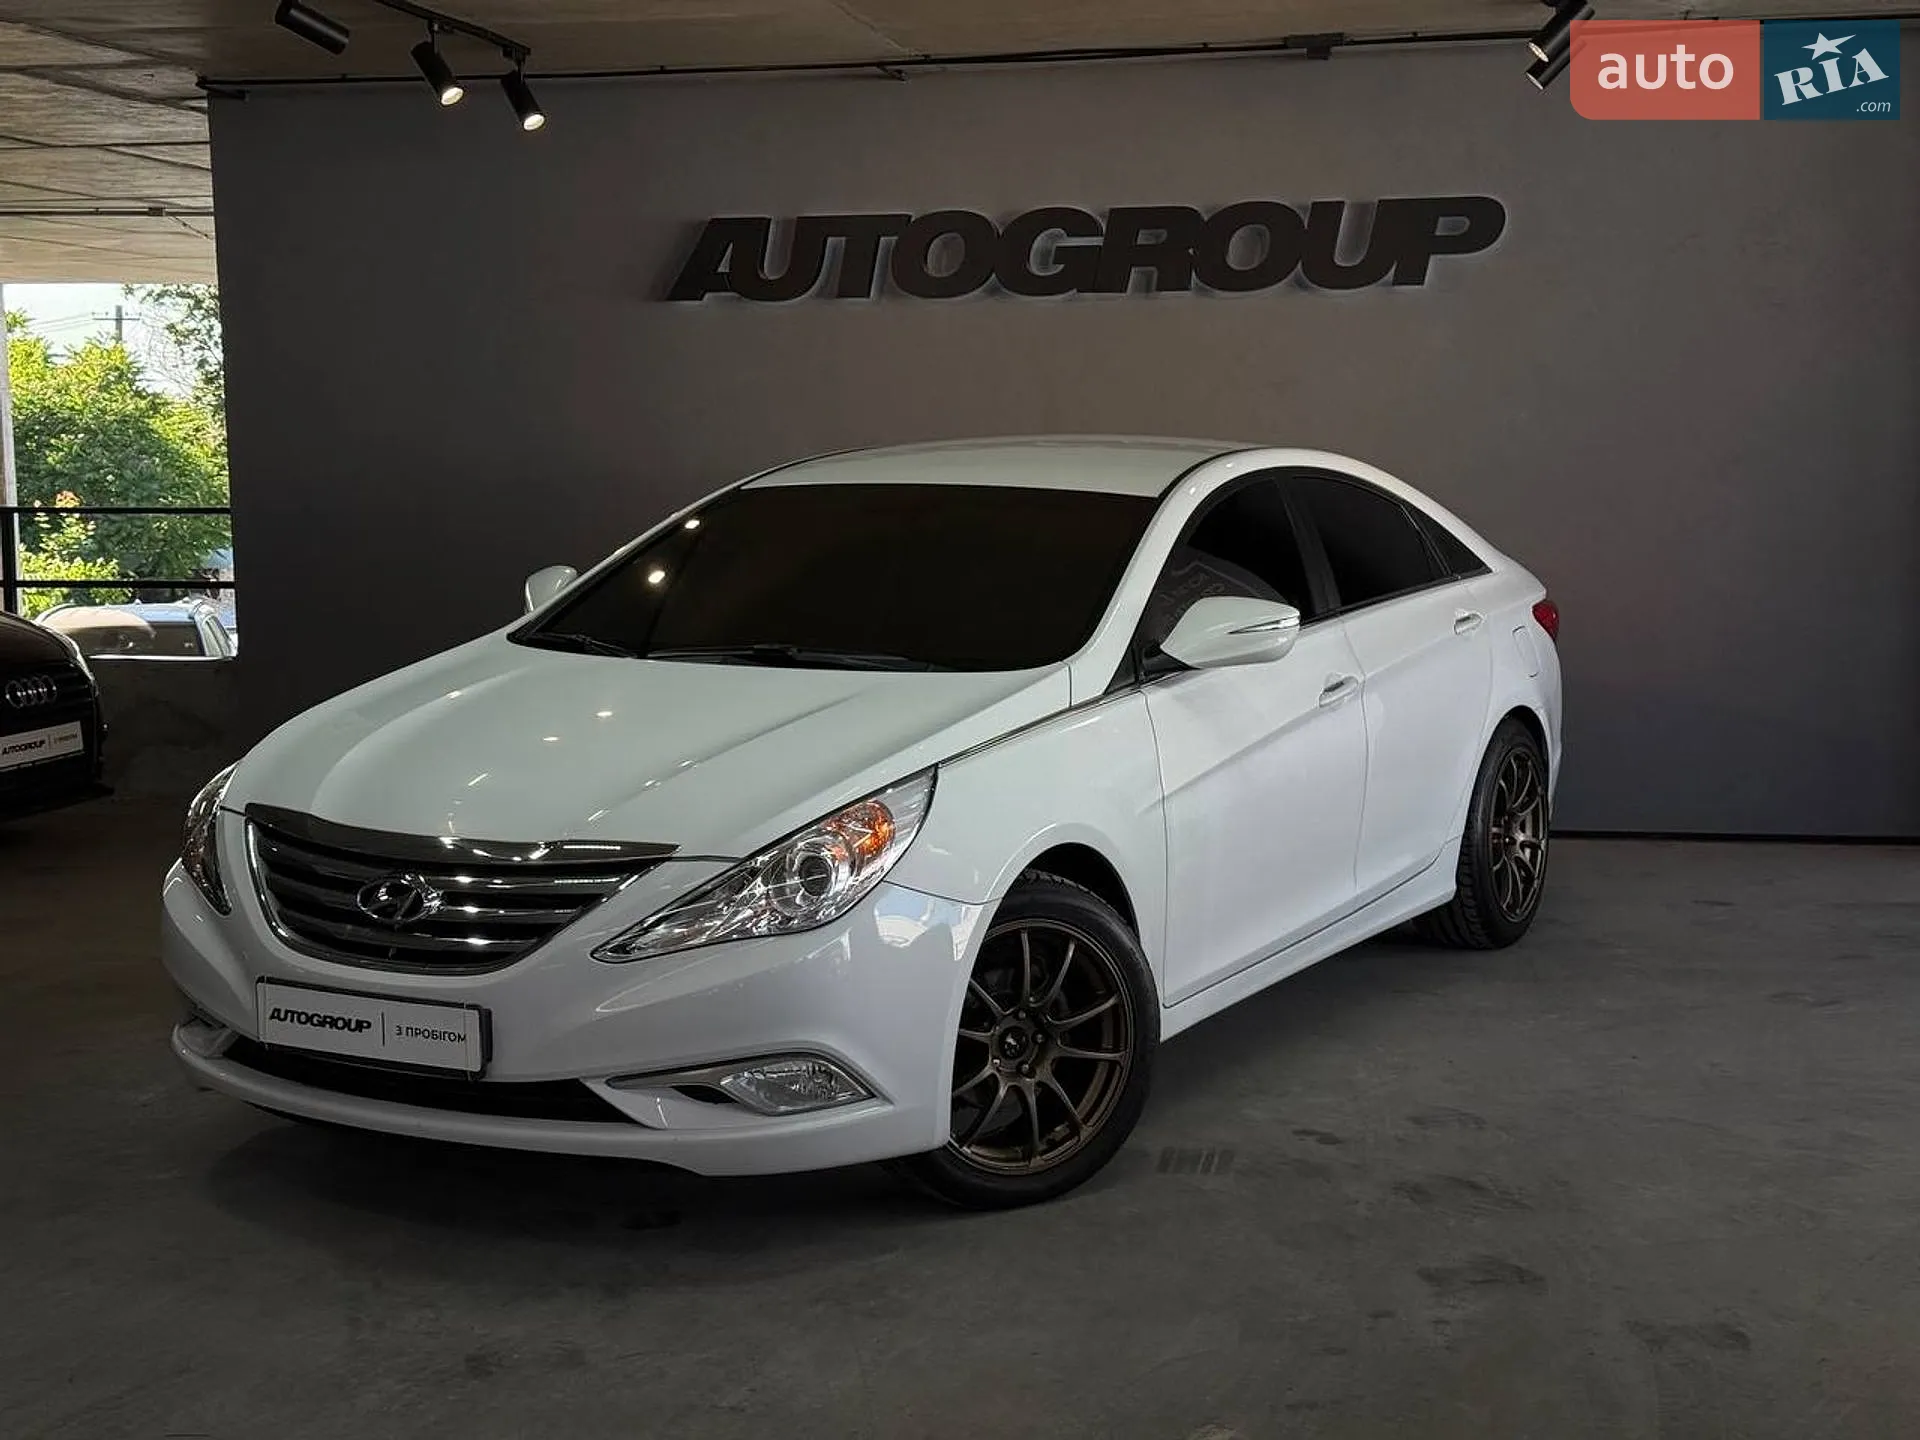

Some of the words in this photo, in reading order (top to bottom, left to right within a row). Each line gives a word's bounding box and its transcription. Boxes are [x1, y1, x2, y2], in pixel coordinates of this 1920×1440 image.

[665, 196, 1507, 302] AUTOGROUP
[269, 1008, 372, 1033] AUTOGROUP
[406, 1027, 467, 1043] ПРОБІГОМ
